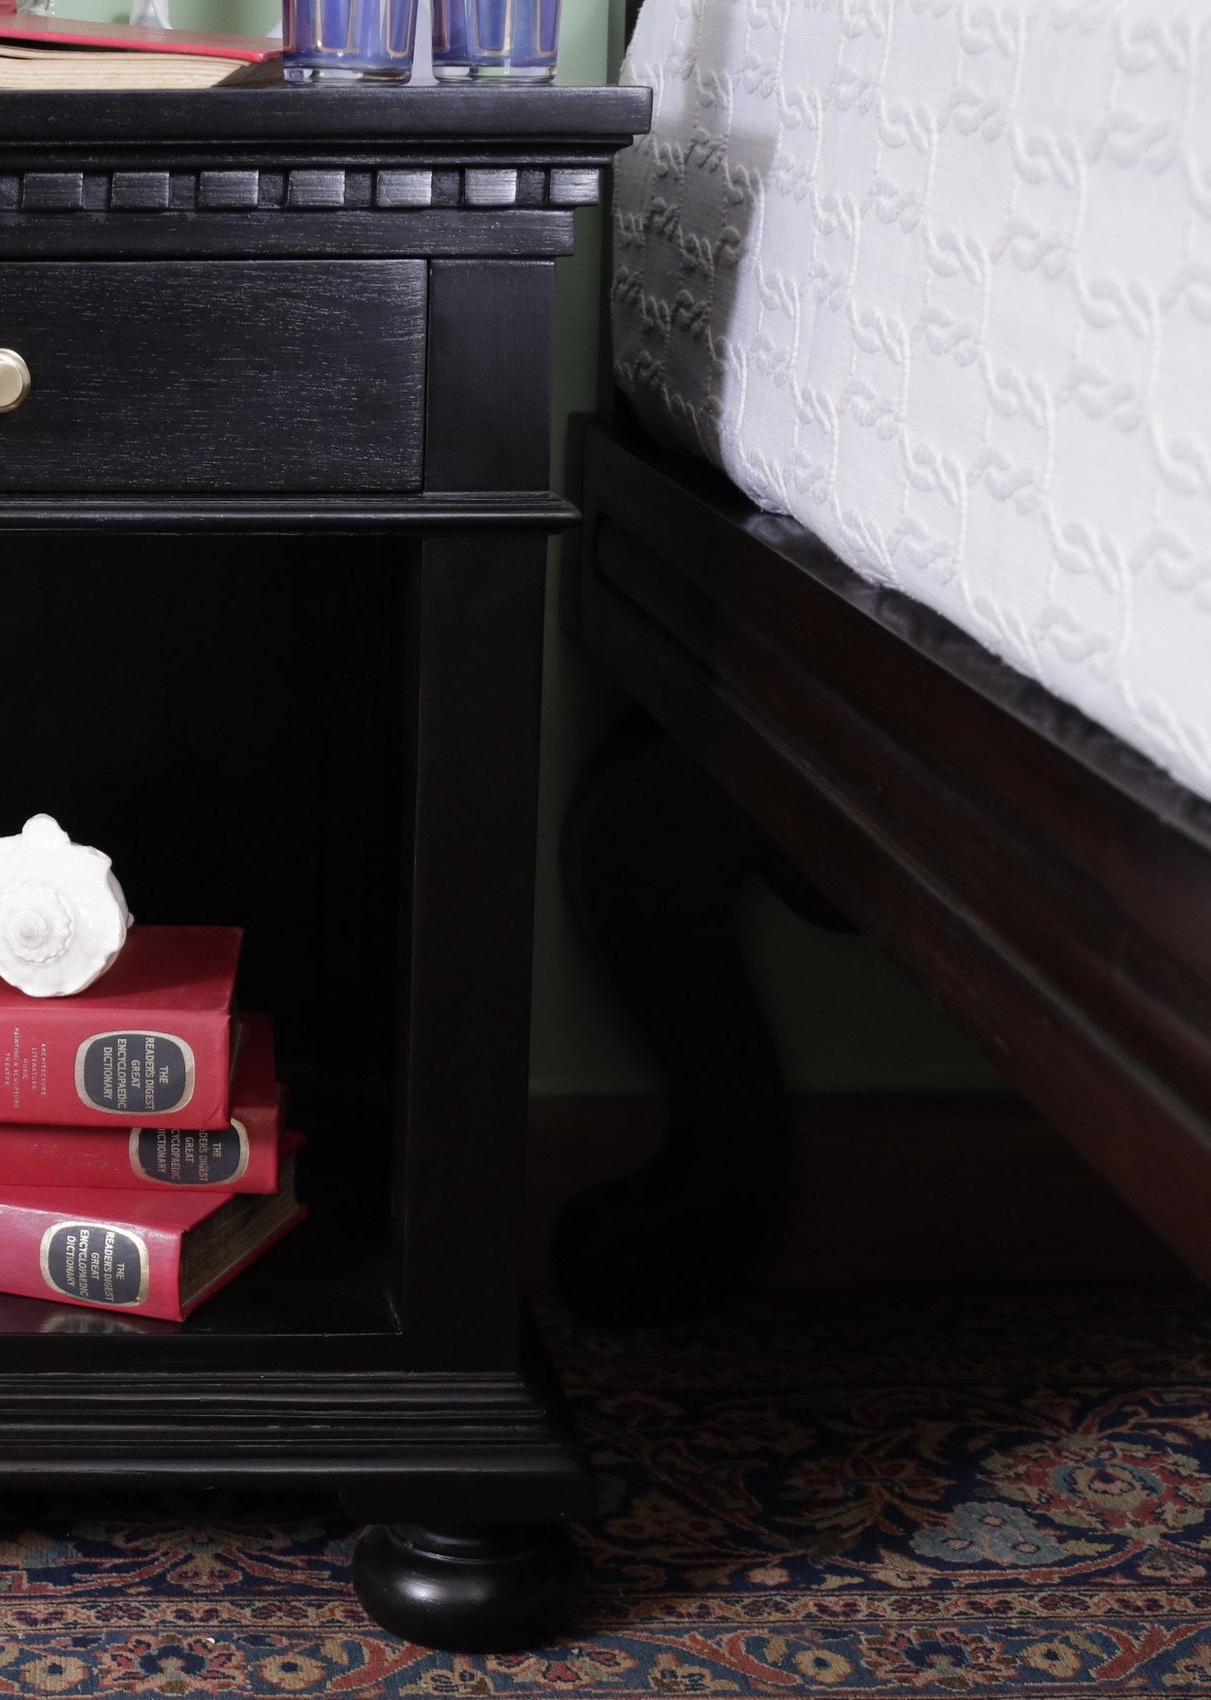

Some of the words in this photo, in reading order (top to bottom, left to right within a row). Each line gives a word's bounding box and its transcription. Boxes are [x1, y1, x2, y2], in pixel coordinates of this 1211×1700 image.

[145, 1037, 155, 1078] READER'S
[103, 1046, 113, 1100] DICTIONARY
[117, 1038, 127, 1109] ENCYCLOPAEDIC
[131, 1059, 141, 1089] GREAT
[159, 1066, 169, 1084] THE
[145, 1079, 155, 1110] DIGEST
[171, 1128, 181, 1181] CYCLOPAEDIC
[185, 1136, 195, 1164] GREAT
[199, 1129, 208, 1153] DER'S
[212, 1142, 222, 1159] THE
[199, 1155, 209, 1182] DIGEST
[65, 1235, 76, 1288] DICTIONARY
[78, 1229, 90, 1297] ENCYCLOPAEDIC
[91, 1252, 100, 1281] GREAT
[103, 1231, 115, 1272] READER'S
[116, 1262, 125, 1281] THE
[103, 1273, 114, 1303] DIGEST
